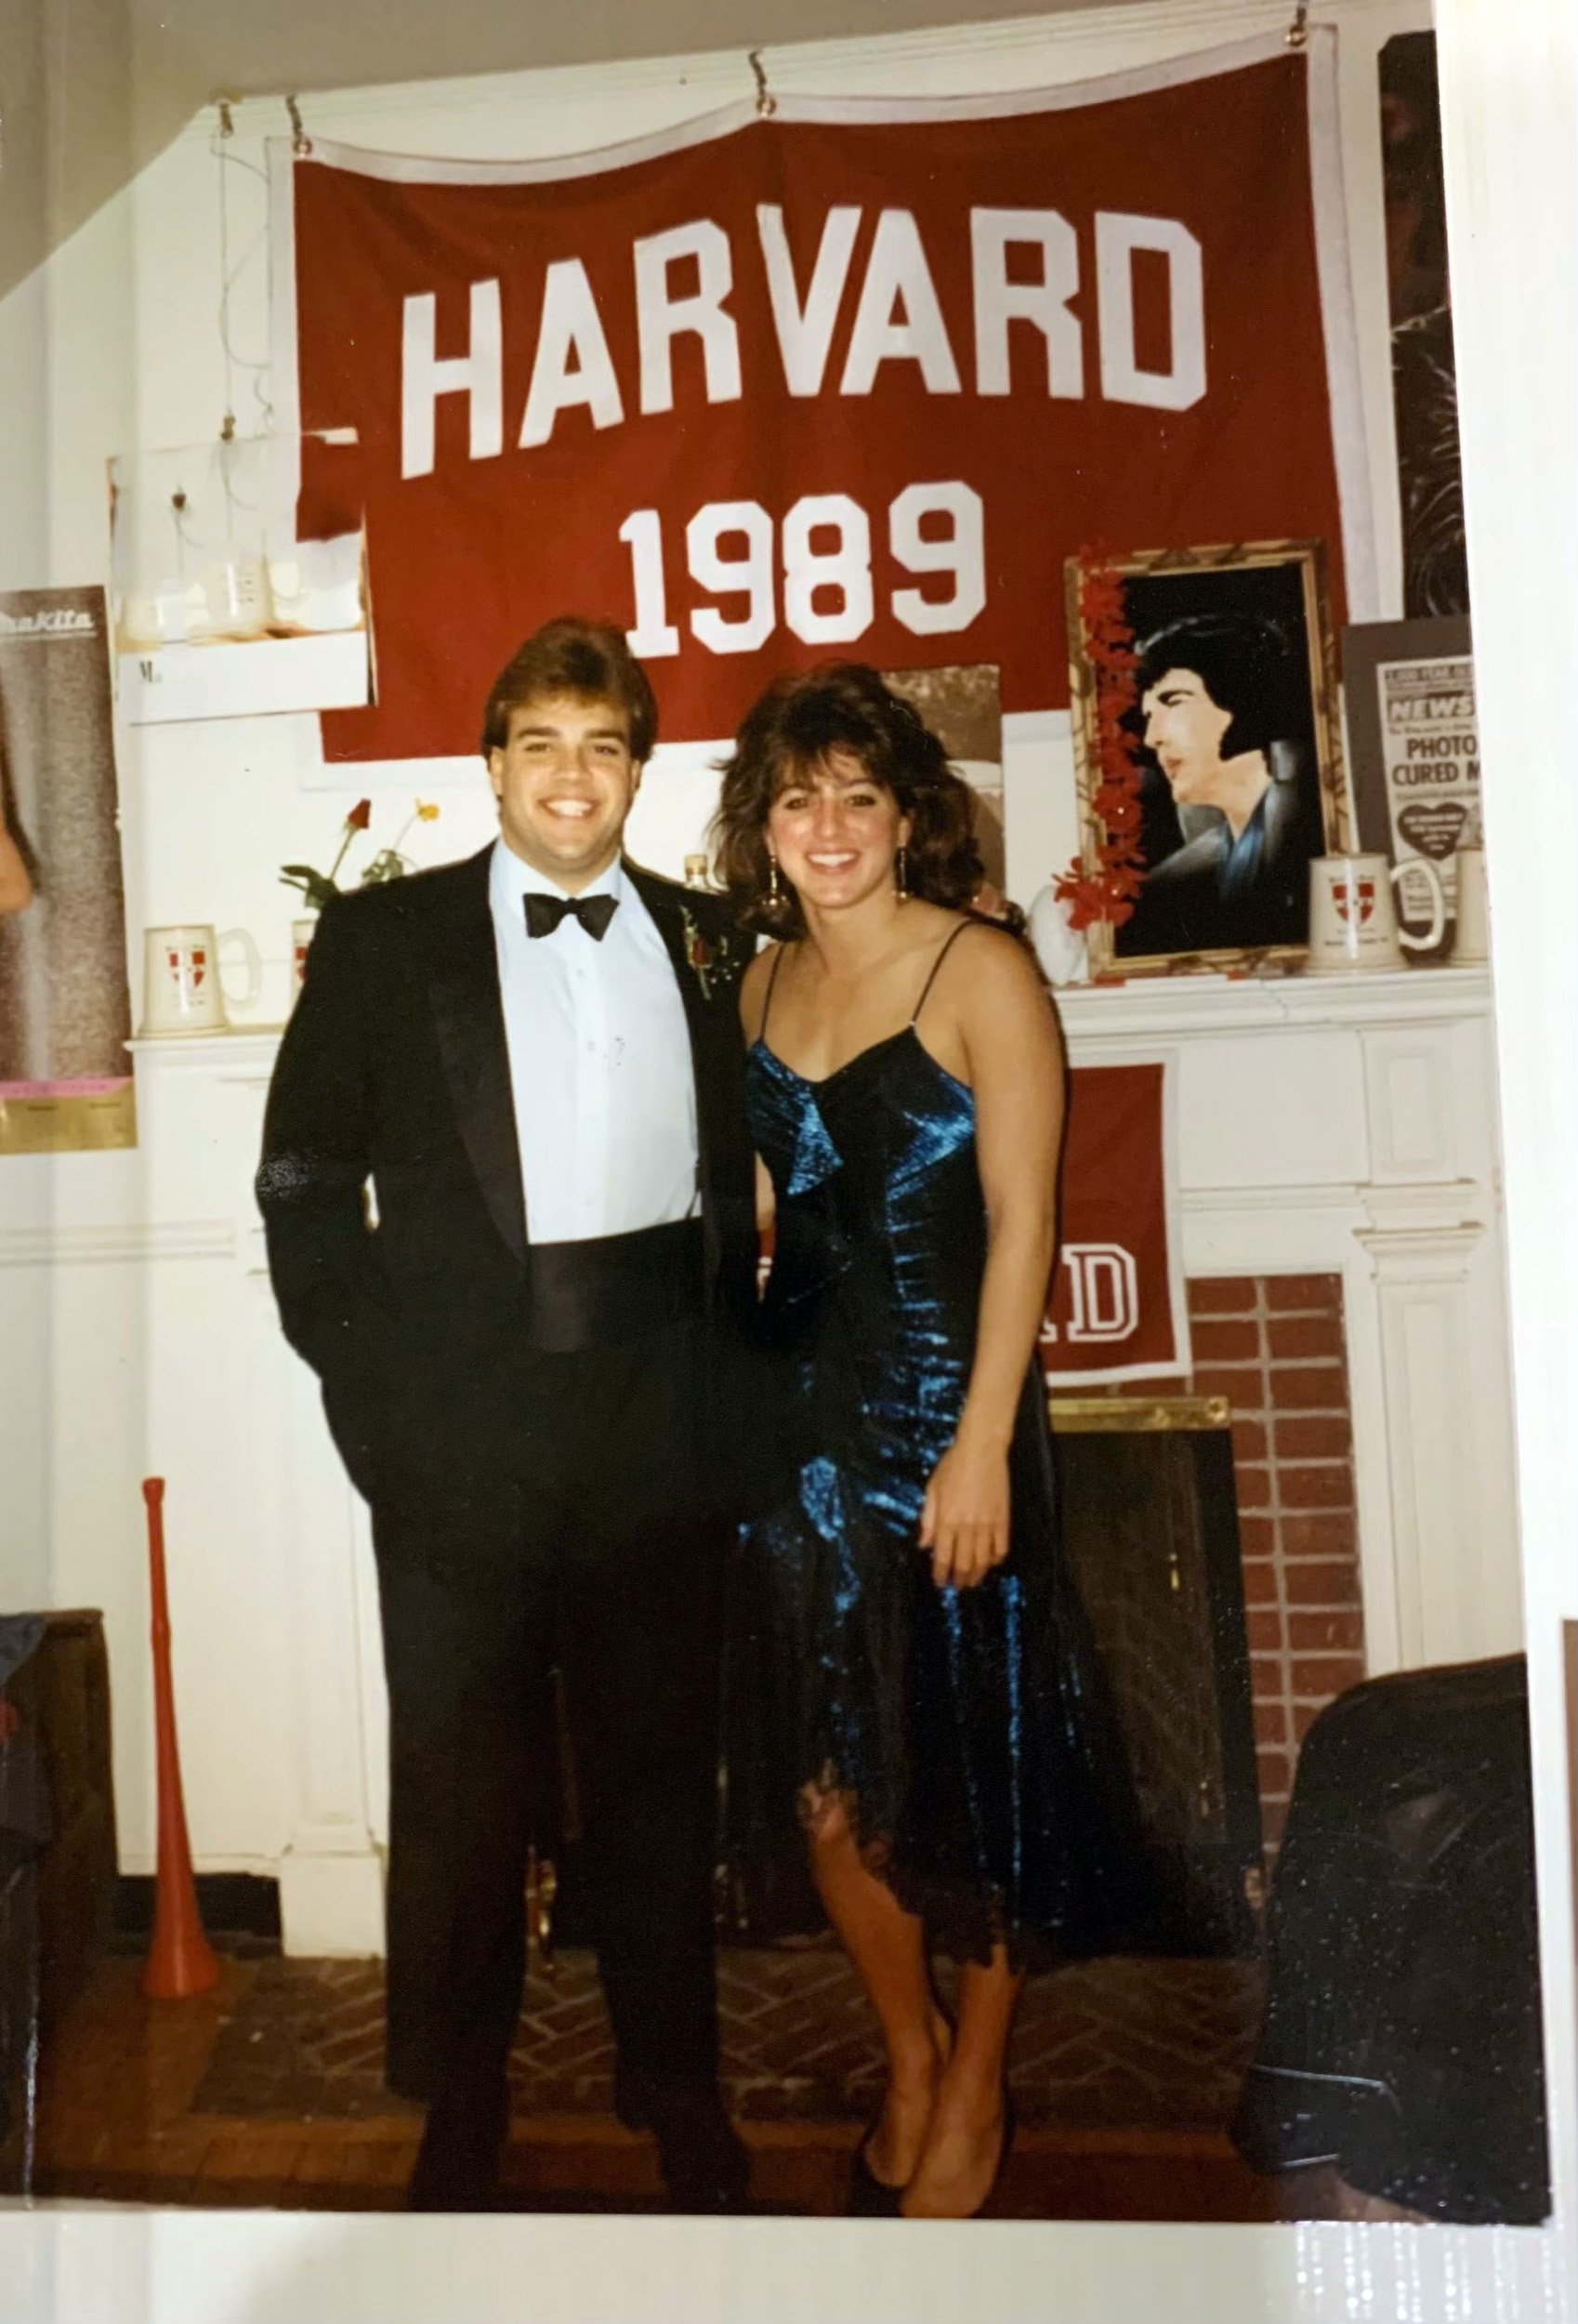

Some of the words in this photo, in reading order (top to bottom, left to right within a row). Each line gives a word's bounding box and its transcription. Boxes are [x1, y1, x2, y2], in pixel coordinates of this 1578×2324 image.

[401, 202, 1208, 481] HARVARD
[619, 481, 987, 660] 1989
[1390, 696, 1475, 721] NEWS
[1393, 761, 1460, 786] CURED
[1407, 734, 1477, 759] PHOTO
[1038, 1243, 1139, 1343] D
